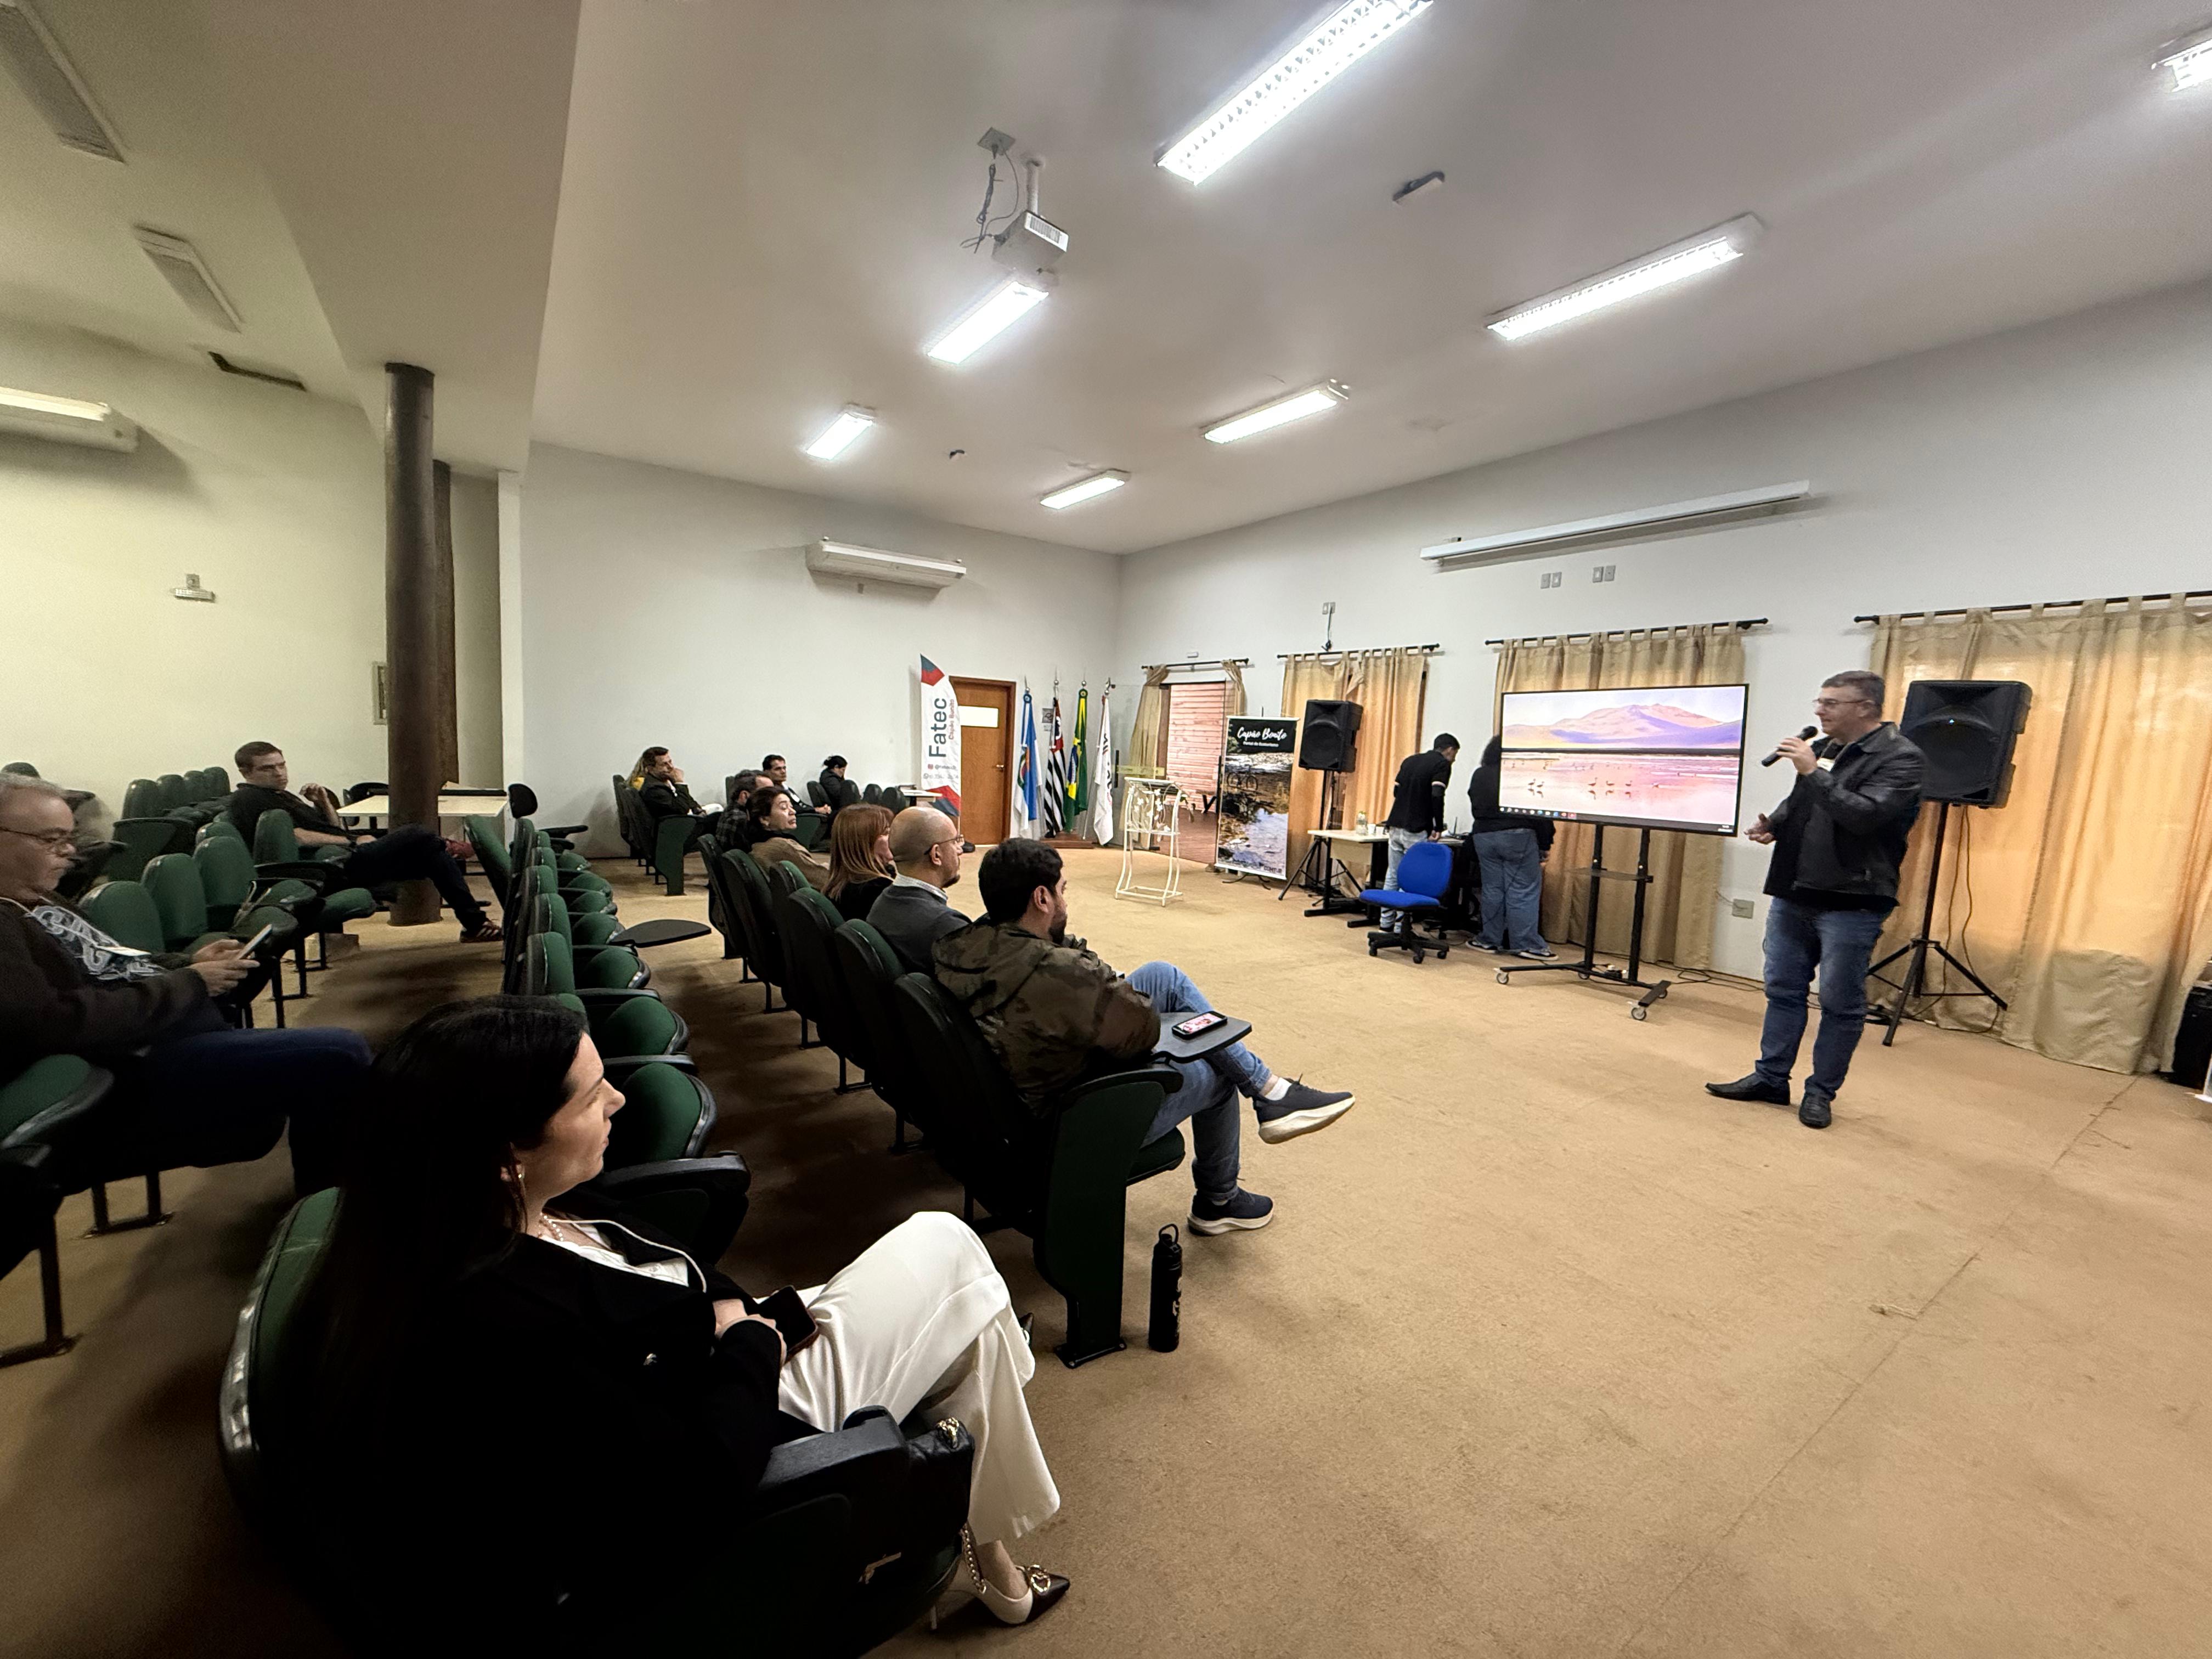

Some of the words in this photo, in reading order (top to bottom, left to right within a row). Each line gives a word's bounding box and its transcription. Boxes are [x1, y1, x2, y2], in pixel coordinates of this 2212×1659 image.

[928, 698, 947, 757] Fatec
[1237, 727, 1261, 741] Capão
[1262, 727, 1287, 741] Bonito
